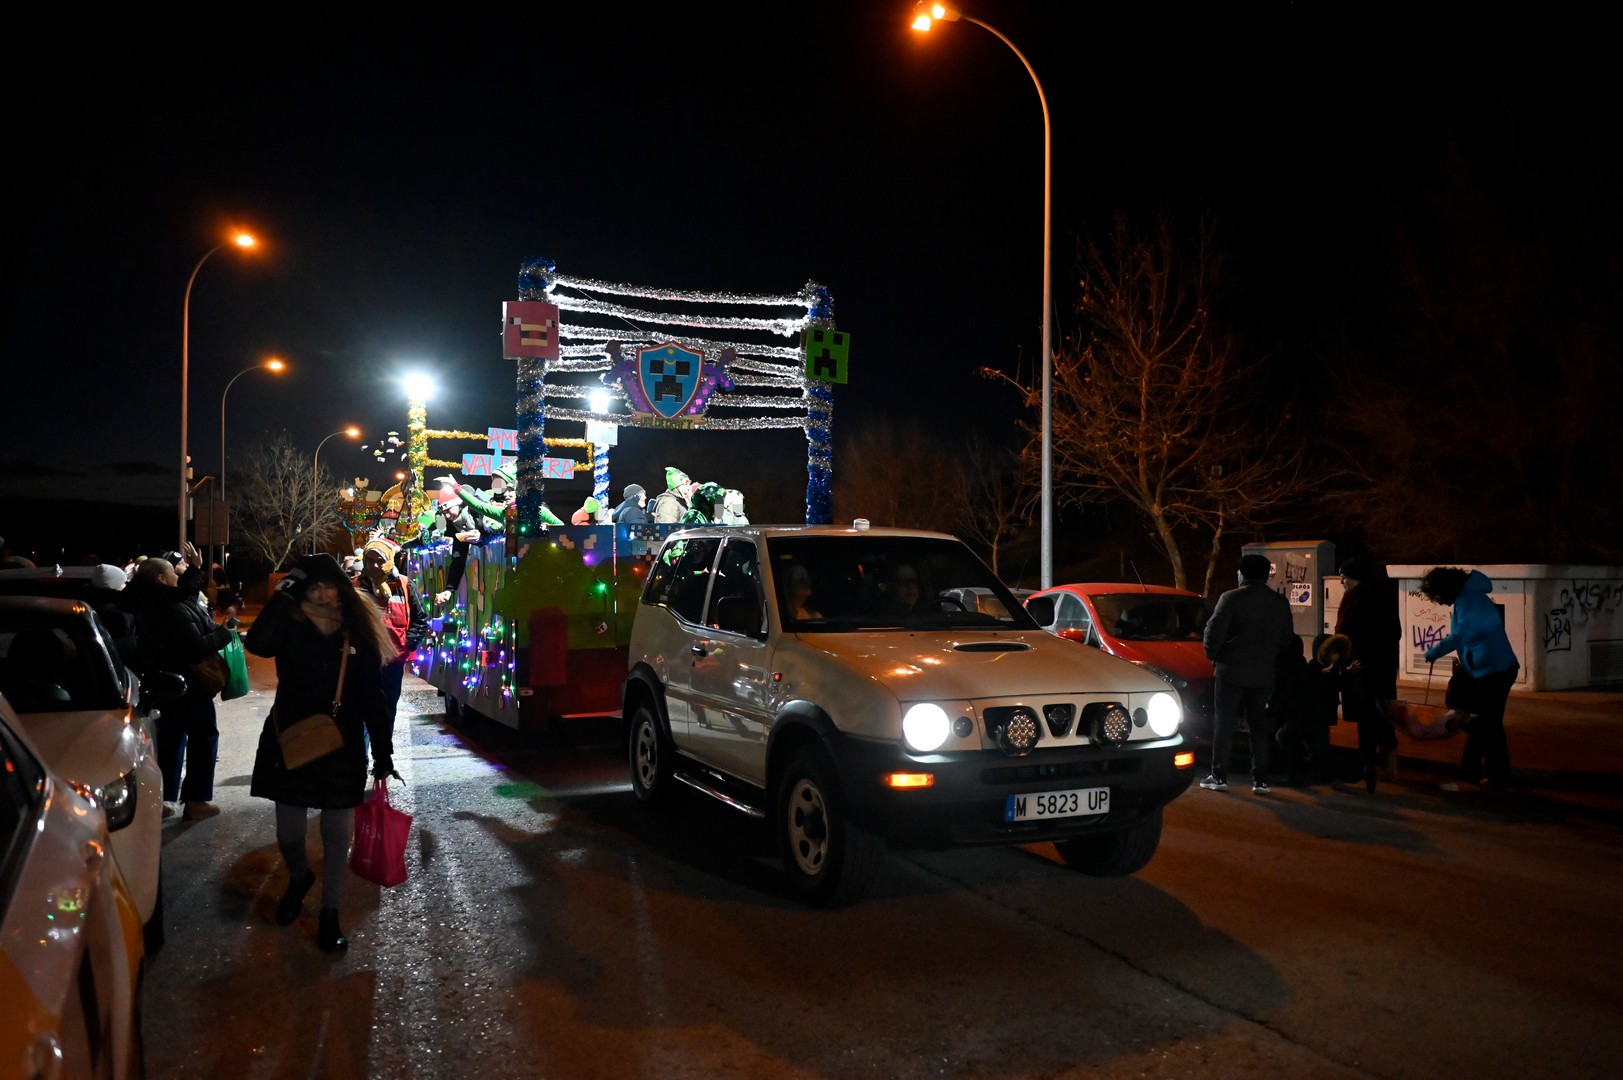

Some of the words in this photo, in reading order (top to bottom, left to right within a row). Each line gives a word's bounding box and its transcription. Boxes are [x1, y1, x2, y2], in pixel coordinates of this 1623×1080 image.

[1016, 797, 1027, 817] M
[1037, 793, 1078, 815] 5823
[1088, 790, 1108, 811] UP
